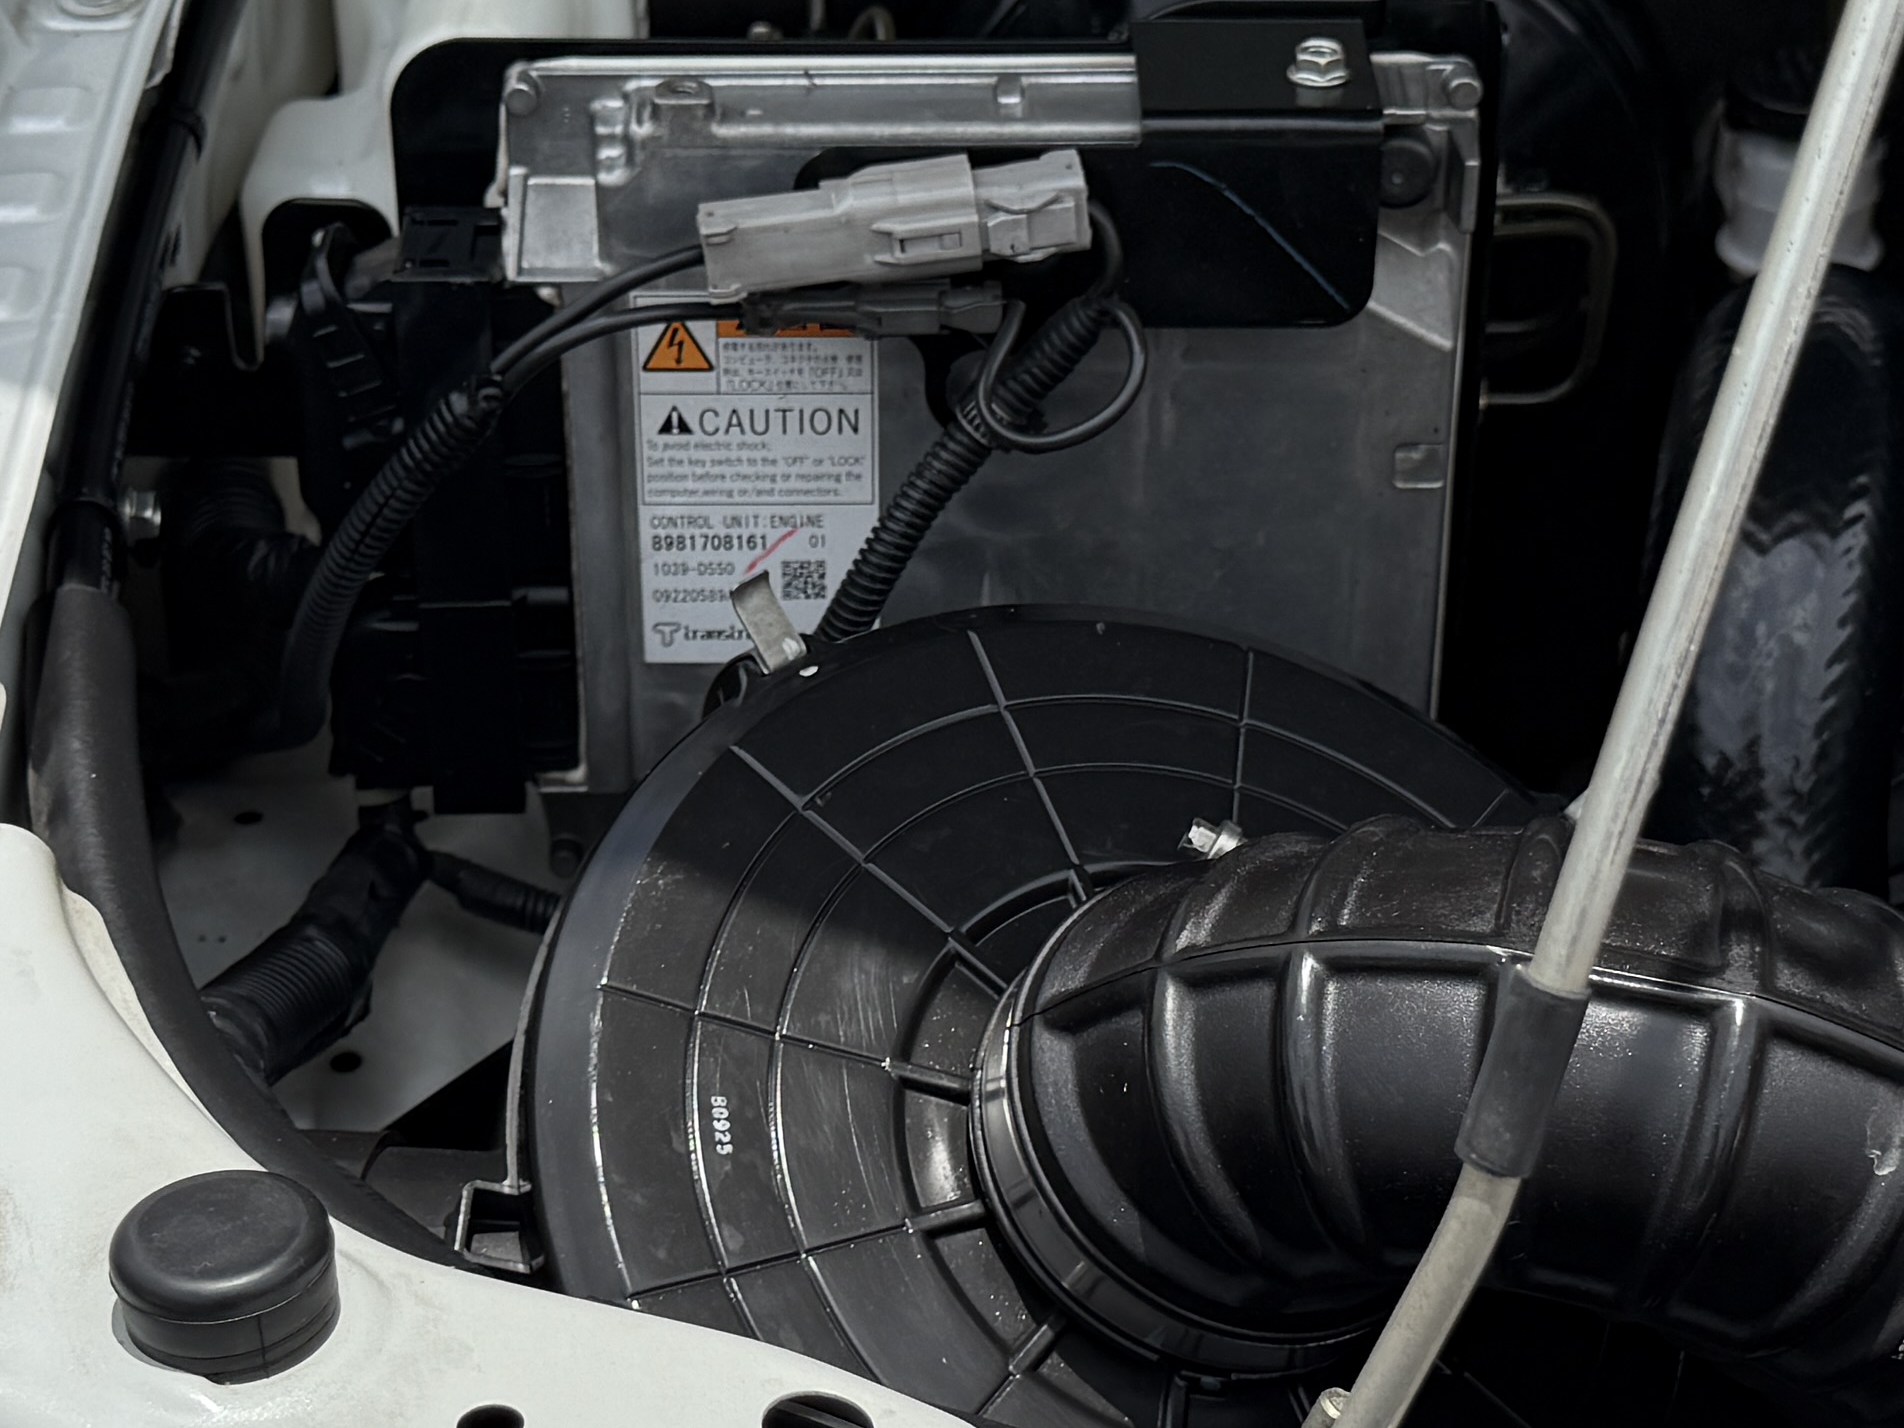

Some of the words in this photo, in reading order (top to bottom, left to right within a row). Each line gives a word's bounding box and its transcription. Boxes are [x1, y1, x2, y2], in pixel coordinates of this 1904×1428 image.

[698, 408, 860, 436] CAUTION
[667, 457, 684, 468] the
[687, 457, 706, 470] key
[710, 457, 745, 468] switch
[746, 458, 759, 468] to
[761, 457, 778, 468] the
[650, 515, 715, 529] CONTROL
[652, 534, 770, 552] 8981708161
[808, 534, 827, 549] 01
